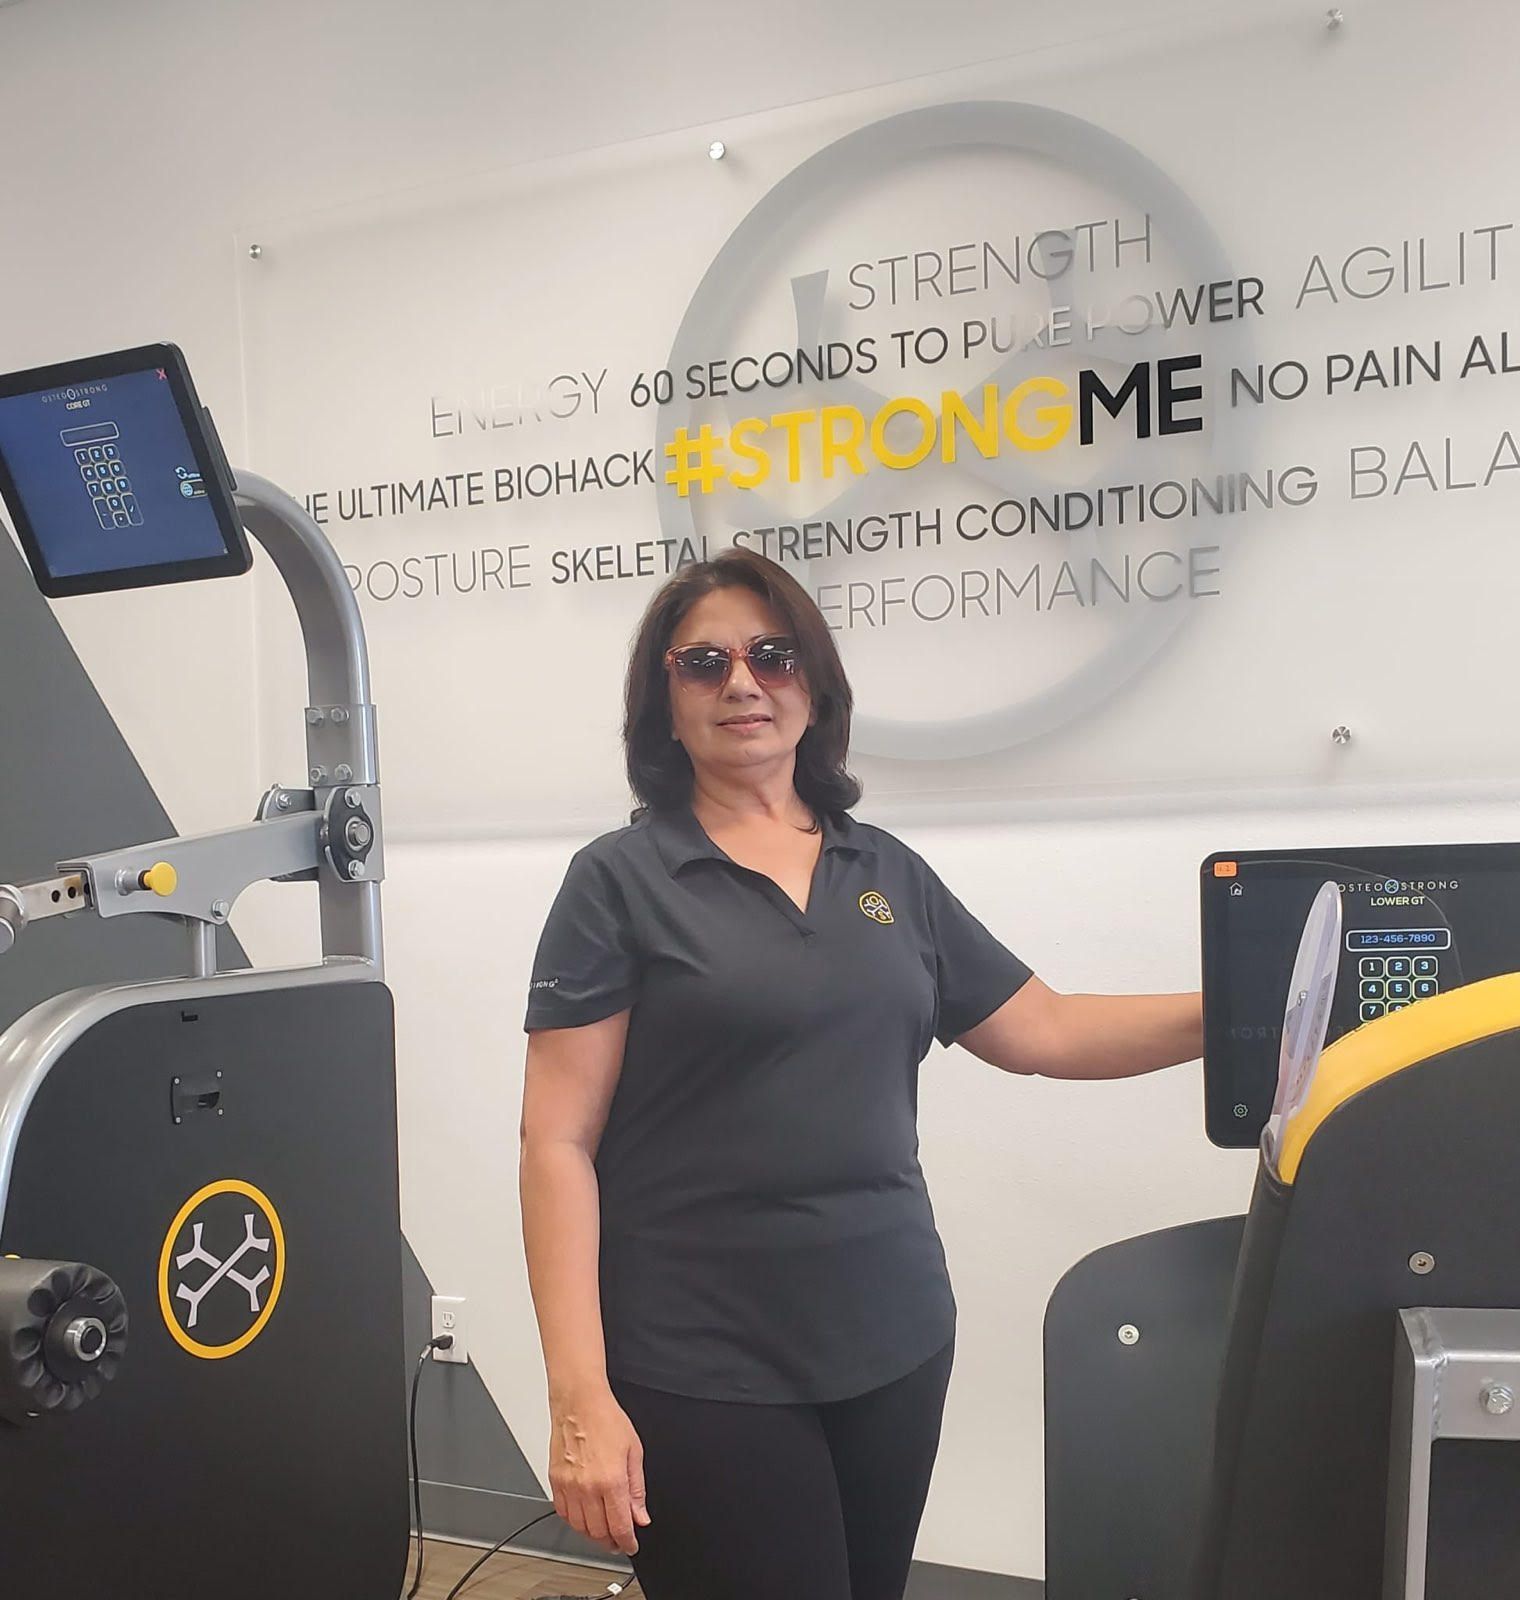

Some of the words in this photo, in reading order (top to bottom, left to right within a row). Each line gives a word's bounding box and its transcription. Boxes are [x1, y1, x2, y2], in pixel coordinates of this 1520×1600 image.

[848, 213, 1151, 311] STRENGTH
[630, 370, 674, 408] 60
[686, 338, 878, 400] SECONDS
[891, 327, 949, 369] TO
[962, 304, 1072, 359] PURE
[1086, 277, 1265, 342] POWER
[338, 471, 485, 521] ULTIMATE
[495, 449, 656, 499] BIOHACK
[664, 354, 1204, 498] #STRONGME
[1231, 361, 1309, 407] NO
[1326, 341, 1442, 395] PAIN
[955, 466, 1319, 541] CONDITIONING
[817, 545, 1221, 630] ERFORMANCE
[1400, 880, 1459, 891] STRONG
[1370, 896, 1410, 906] LOWER
[1411, 895, 1425, 905] GT
[1360, 933, 1436, 944] 123-456-7890
[1369, 962, 1375, 971] 1
[1394, 961, 1403, 971] 2
[1420, 960, 1429, 970] 3
[1368, 984, 1377, 993] 4
[1395, 983, 1403, 993] 5
[1421, 983, 1429, 992] 6
[1369, 1005, 1377, 1015] 7
